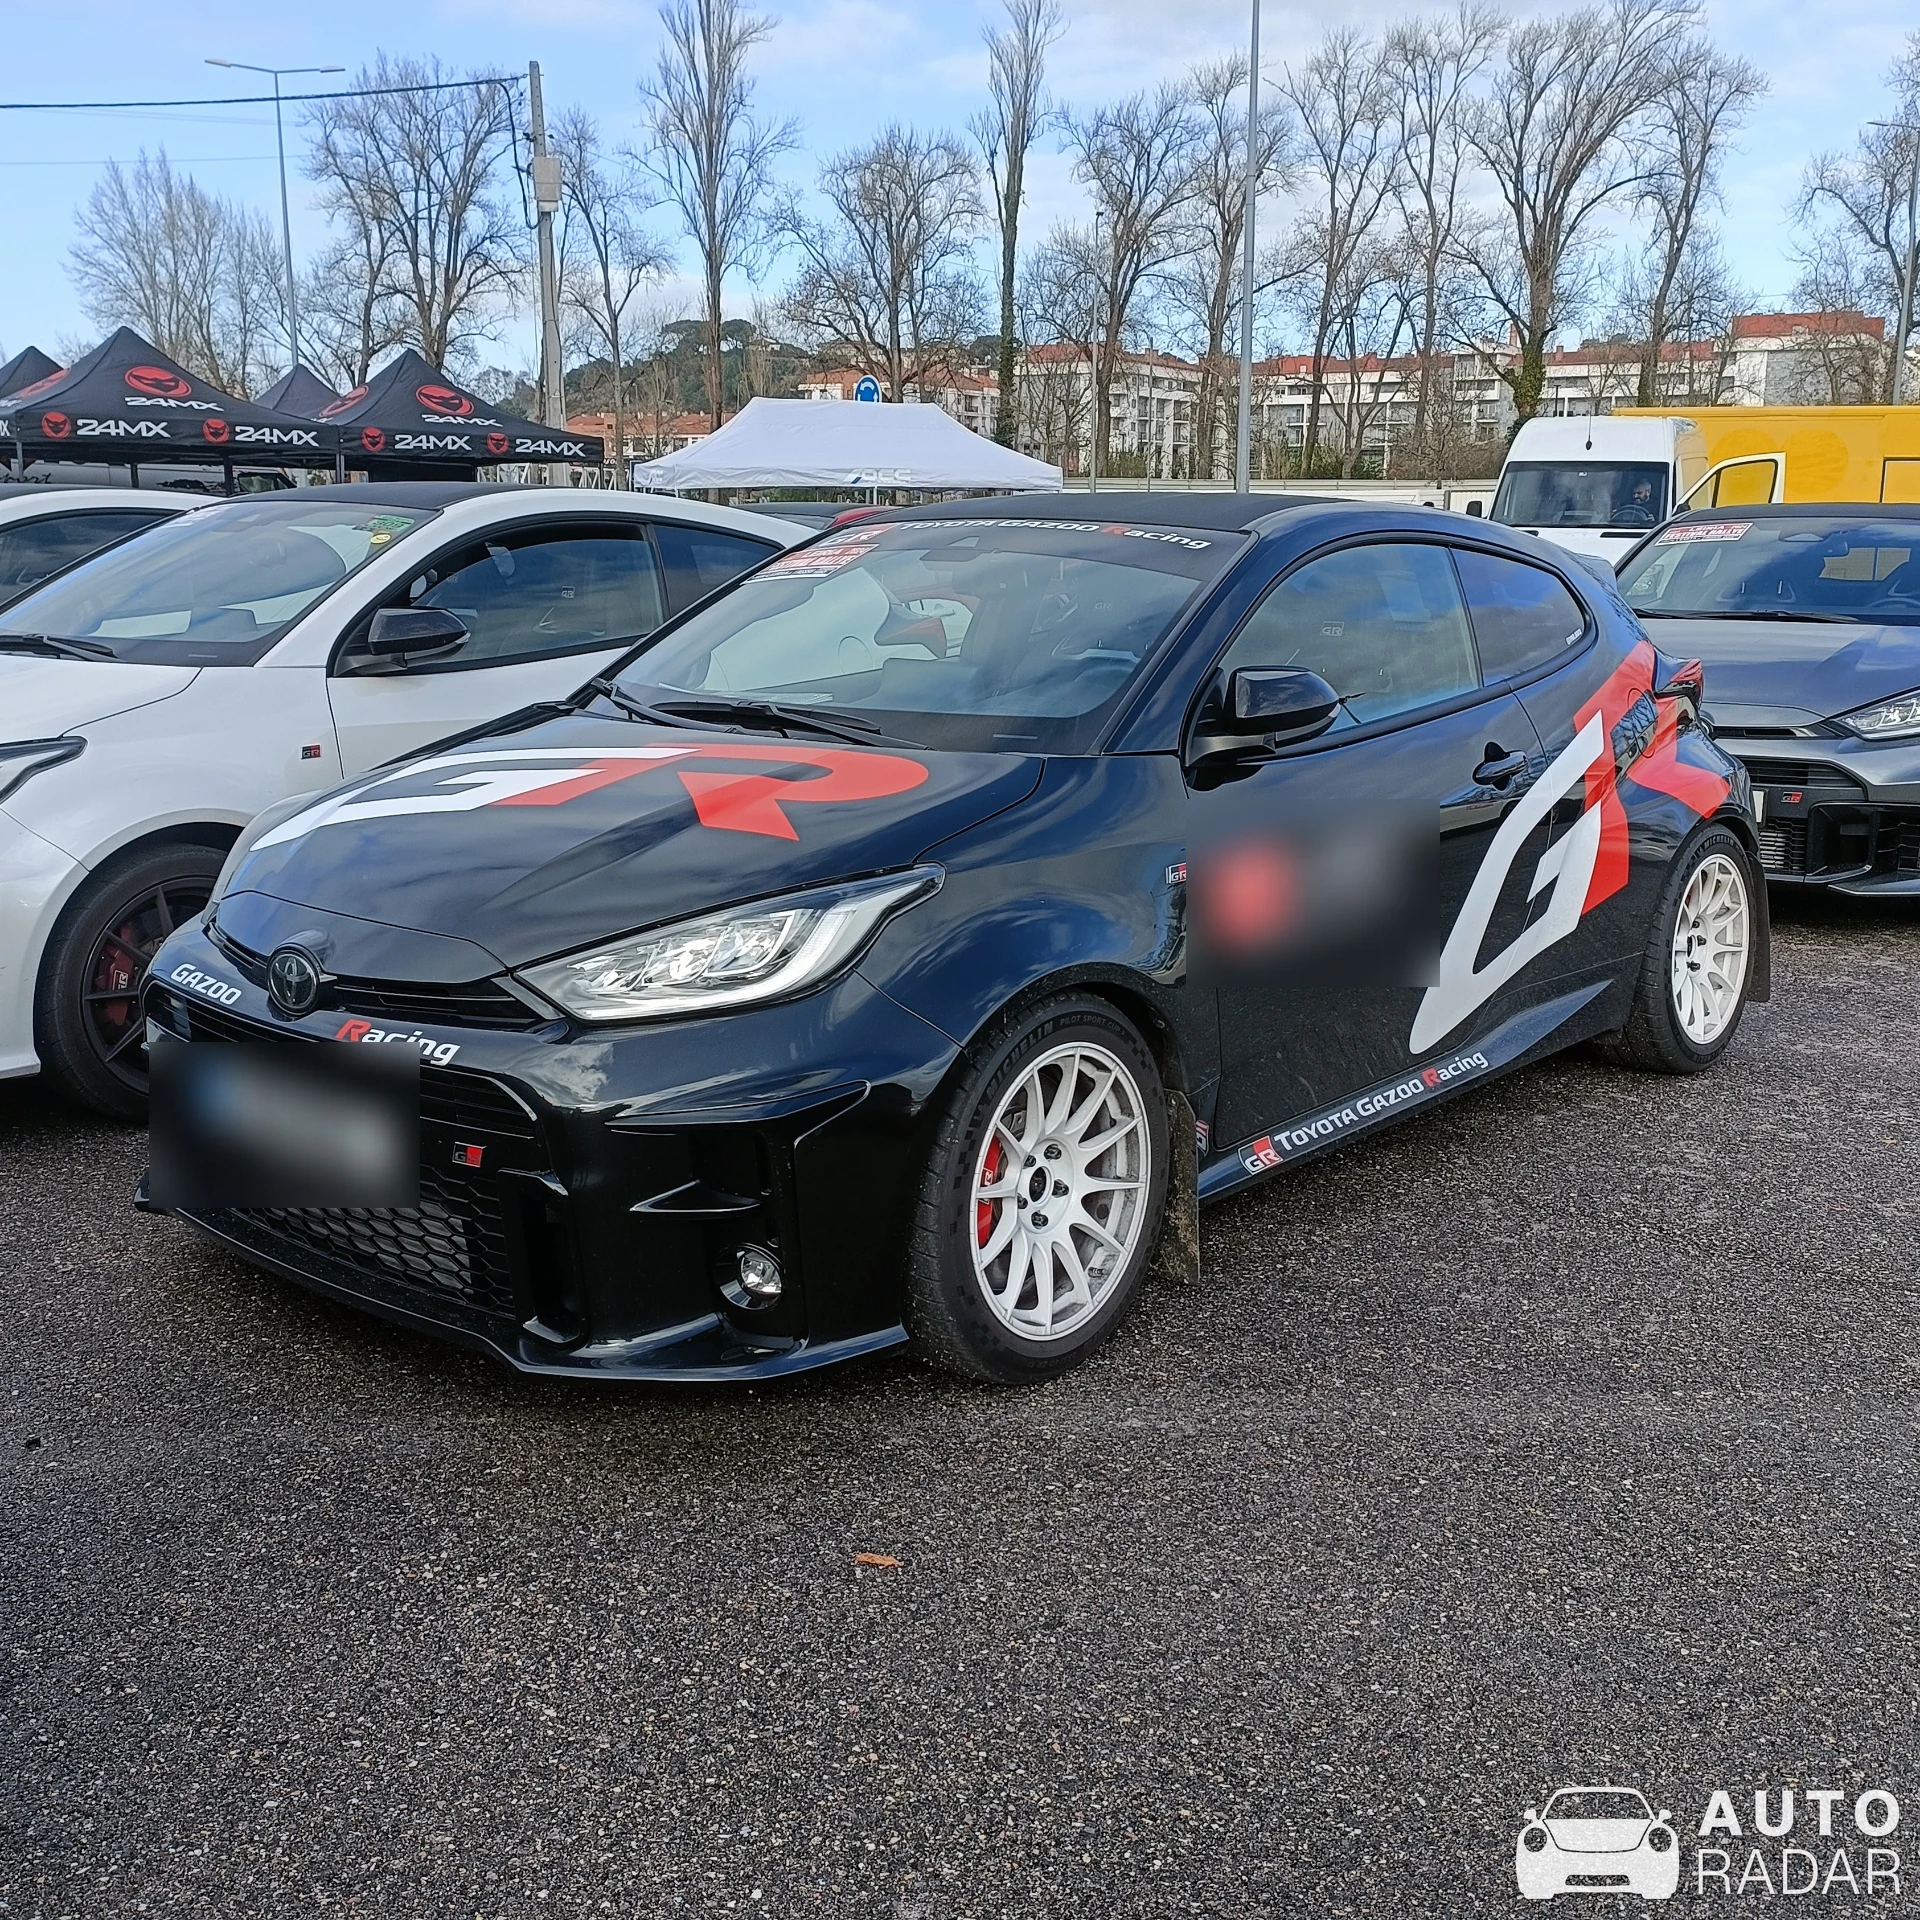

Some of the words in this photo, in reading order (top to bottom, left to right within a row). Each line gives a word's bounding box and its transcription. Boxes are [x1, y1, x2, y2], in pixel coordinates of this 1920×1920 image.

[125, 397, 224, 412] 24MX
[76, 419, 171, 438] 24MX
[421, 414, 503, 428] 24MX
[235, 425, 320, 447] 24MX
[394, 434, 472, 451] 24MX
[515, 438, 587, 457] 24MX
[899, 519, 994, 530] TOYOTA
[998, 519, 1100, 532] GAZOO
[1102, 525, 1212, 549] Racing
[250, 743, 929, 851] GR
[170, 963, 242, 1005] GAZOO
[986, 1020, 1054, 1099] MICHELIN
[1060, 1014, 1081, 1026] PILOT
[1083, 1014, 1106, 1027] SPORT
[1107, 1021, 1121, 1033] CUP
[1244, 1148, 1281, 1171] GR
[1274, 1108, 1359, 1151] TOYOTA
[1356, 1078, 1424, 1117] GAZOO
[1422, 1052, 1488, 1087] Racing
